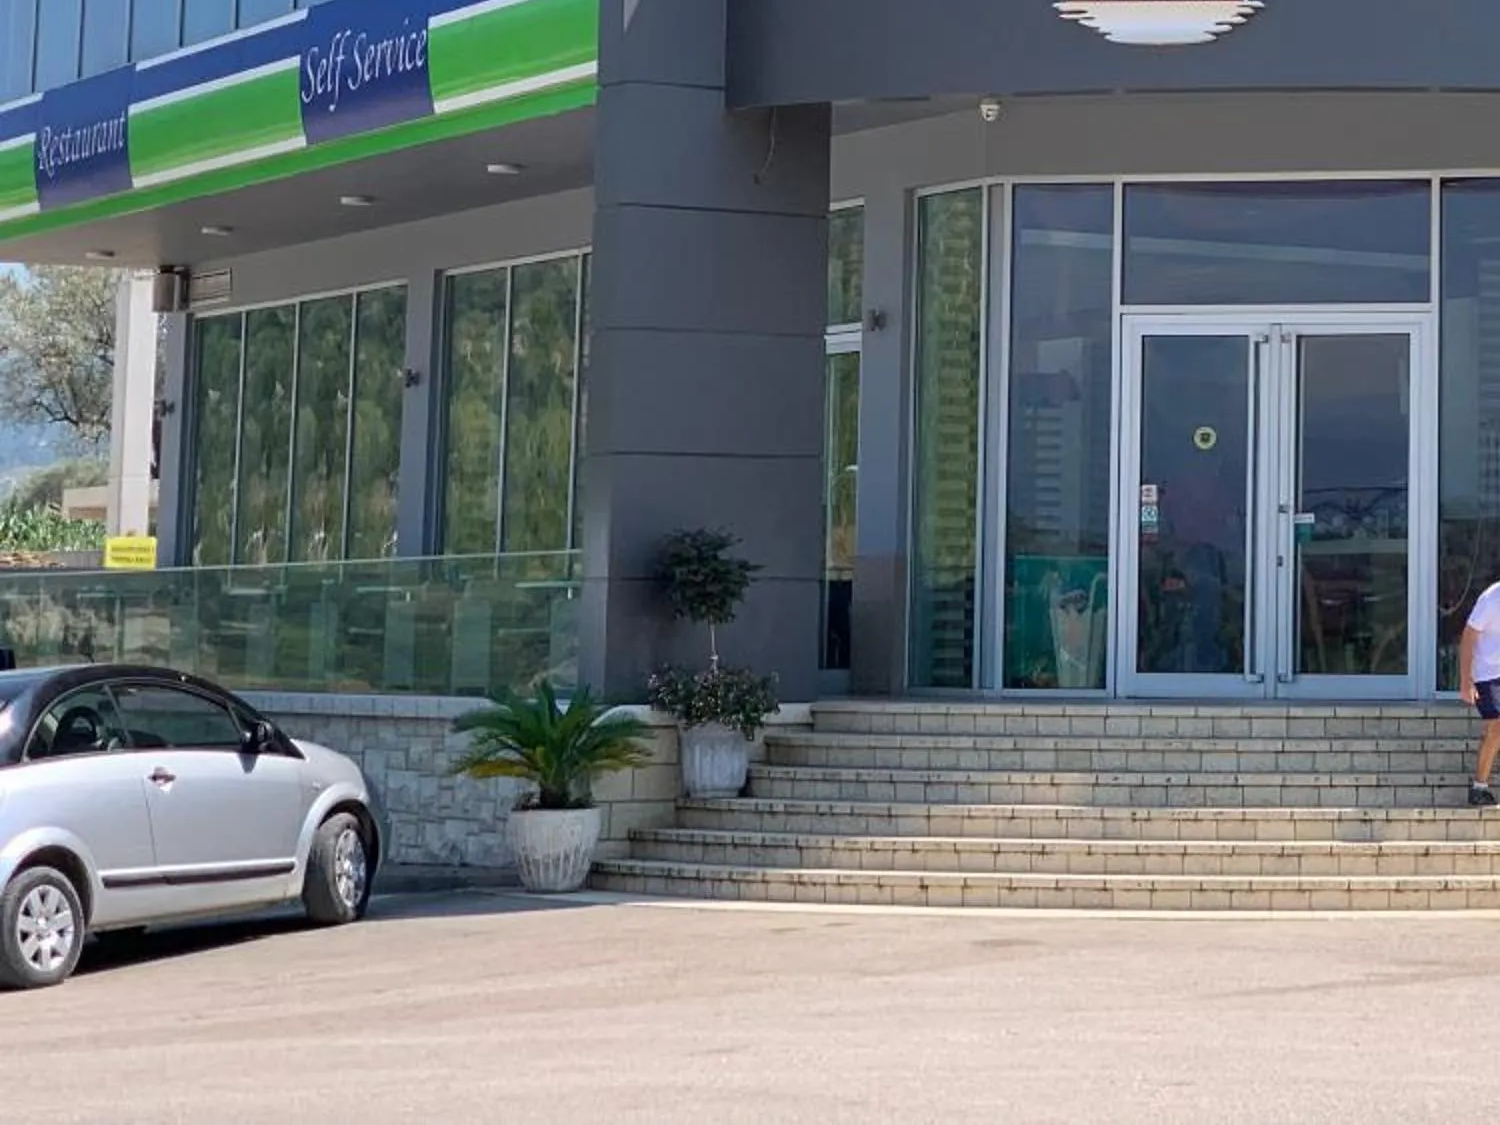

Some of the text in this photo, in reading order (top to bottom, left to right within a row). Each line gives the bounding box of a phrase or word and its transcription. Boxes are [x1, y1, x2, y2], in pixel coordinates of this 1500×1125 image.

[301, 17, 427, 113] Self Service
[38, 110, 126, 180] Restaurant
